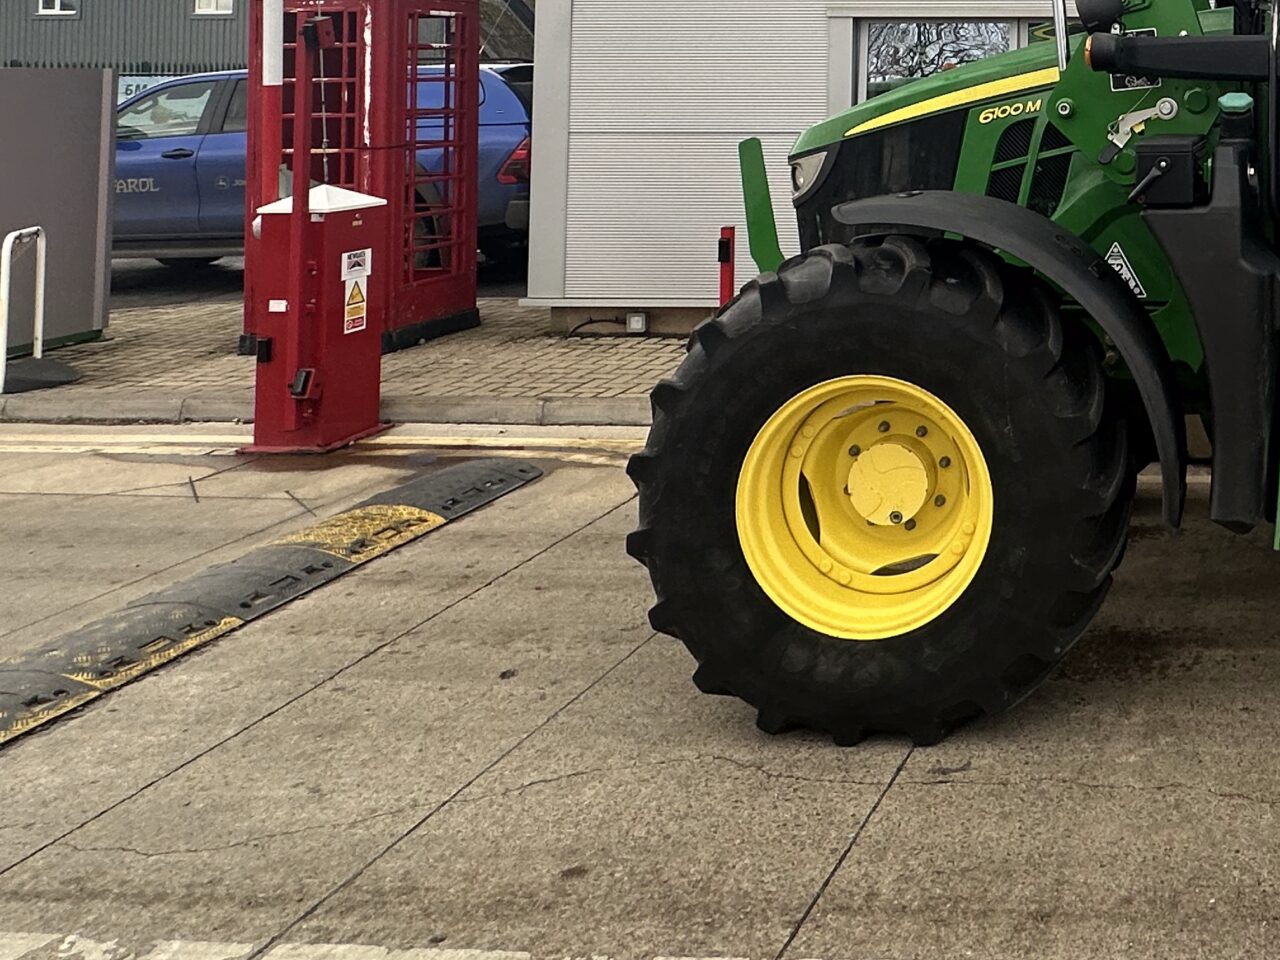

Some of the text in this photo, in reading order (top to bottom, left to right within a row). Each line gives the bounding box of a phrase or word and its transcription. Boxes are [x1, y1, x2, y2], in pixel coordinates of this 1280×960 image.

[978, 99, 1042, 124] 6100 M
[114, 178, 160, 193] AROL
